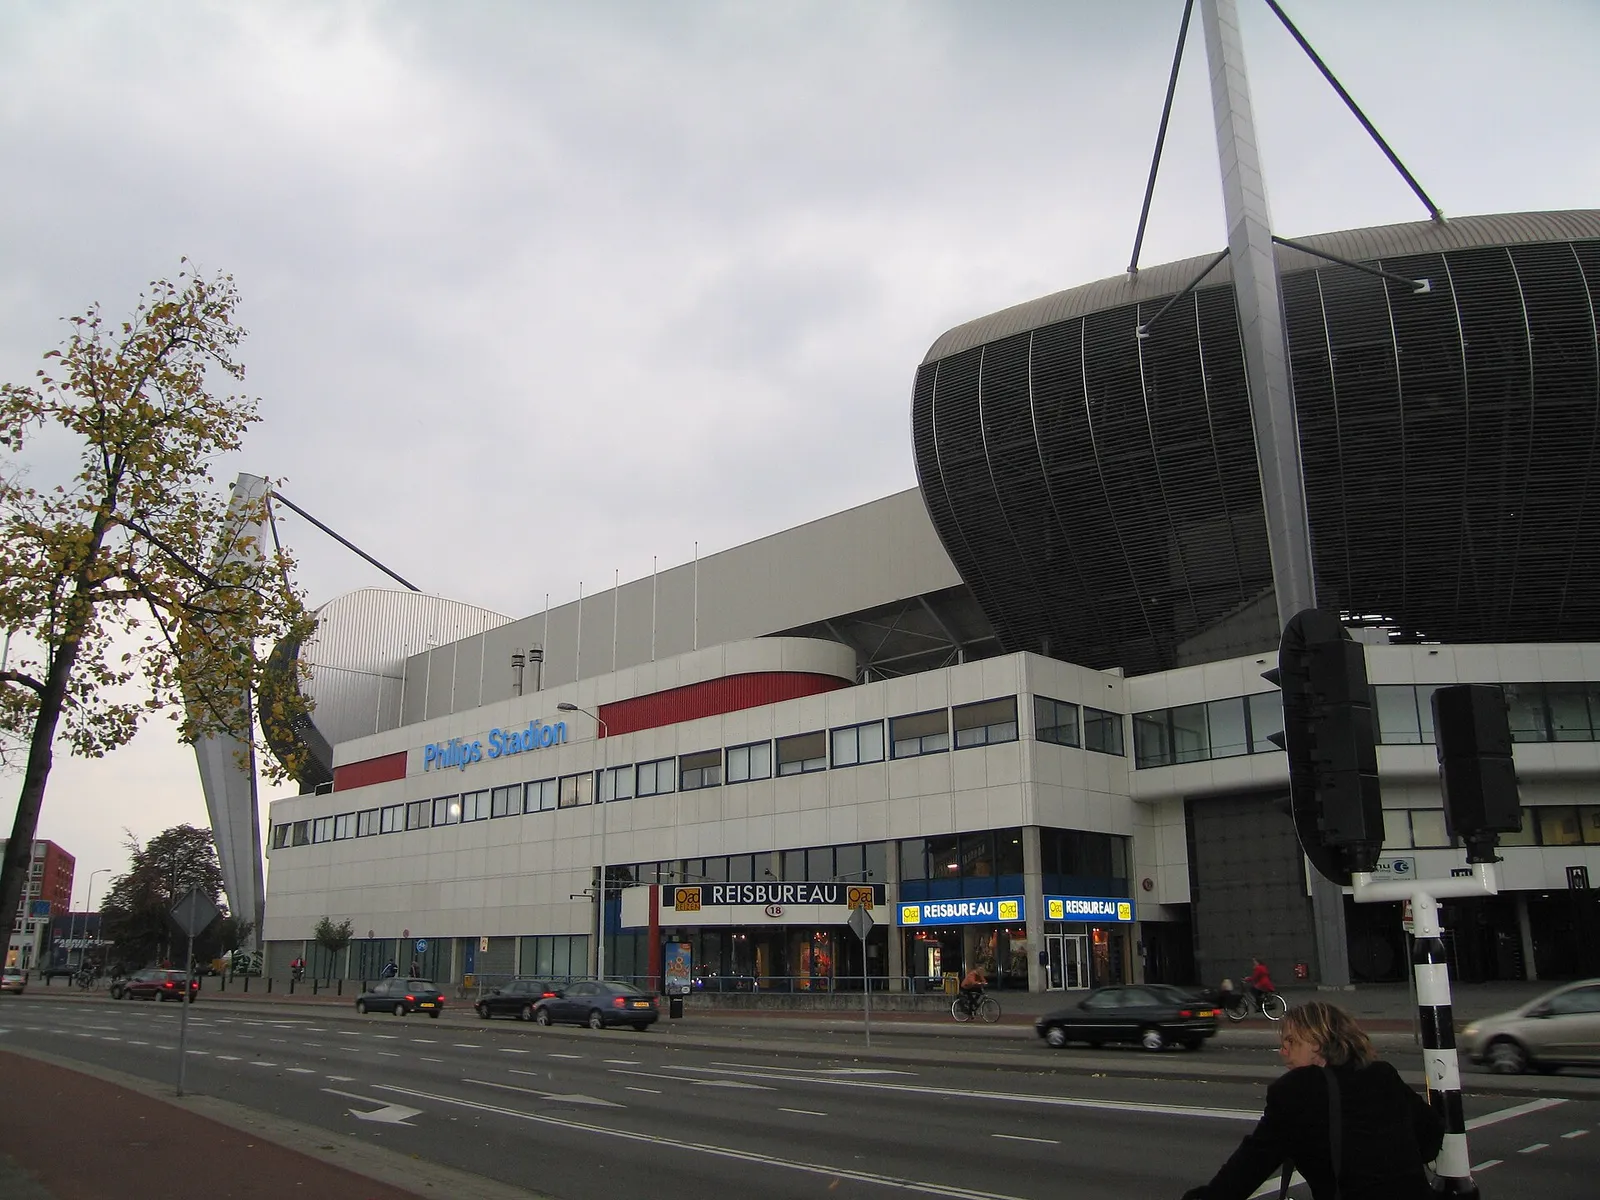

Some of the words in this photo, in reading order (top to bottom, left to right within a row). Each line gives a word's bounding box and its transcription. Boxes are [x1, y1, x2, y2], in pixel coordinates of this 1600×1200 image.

[423, 738, 482, 772] Philips
[488, 719, 567, 758] Stadion
[676, 889, 700, 903] Oad
[713, 885, 837, 903] REISBUREAU
[849, 887, 872, 903] Oad
[676, 903, 700, 911] REIZEN
[770, 906, 782, 914] 18
[849, 902, 873, 910] REEN
[924, 902, 994, 918] REISBUREAU
[1000, 902, 1016, 913] Oad
[1050, 901, 1062, 912] Oad
[1066, 900, 1115, 914] REISBUREAU
[903, 908, 919, 918] Oad
